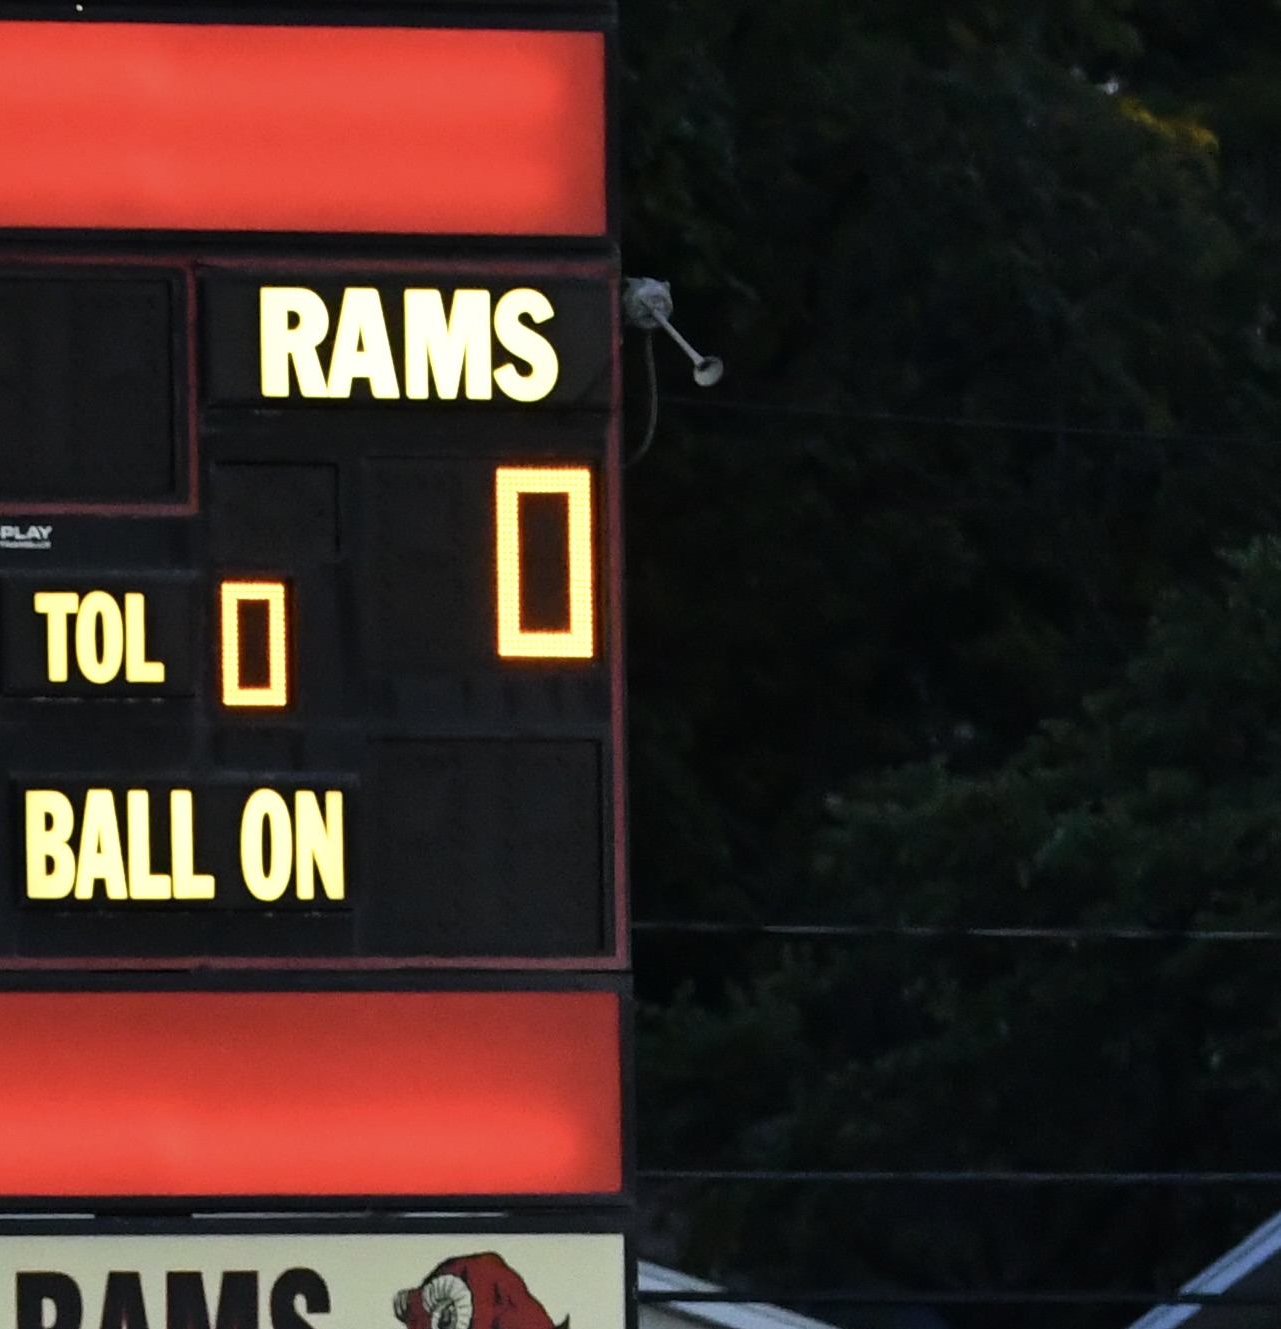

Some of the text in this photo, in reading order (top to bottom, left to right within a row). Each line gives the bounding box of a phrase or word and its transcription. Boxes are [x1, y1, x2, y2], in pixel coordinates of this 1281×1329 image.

[257, 284, 561, 404] RAMS
[493, 465, 596, 661] 0
[32, 588, 167, 686] TOL
[219, 580, 289, 709] 0
[23, 786, 347, 904] BALL ON
